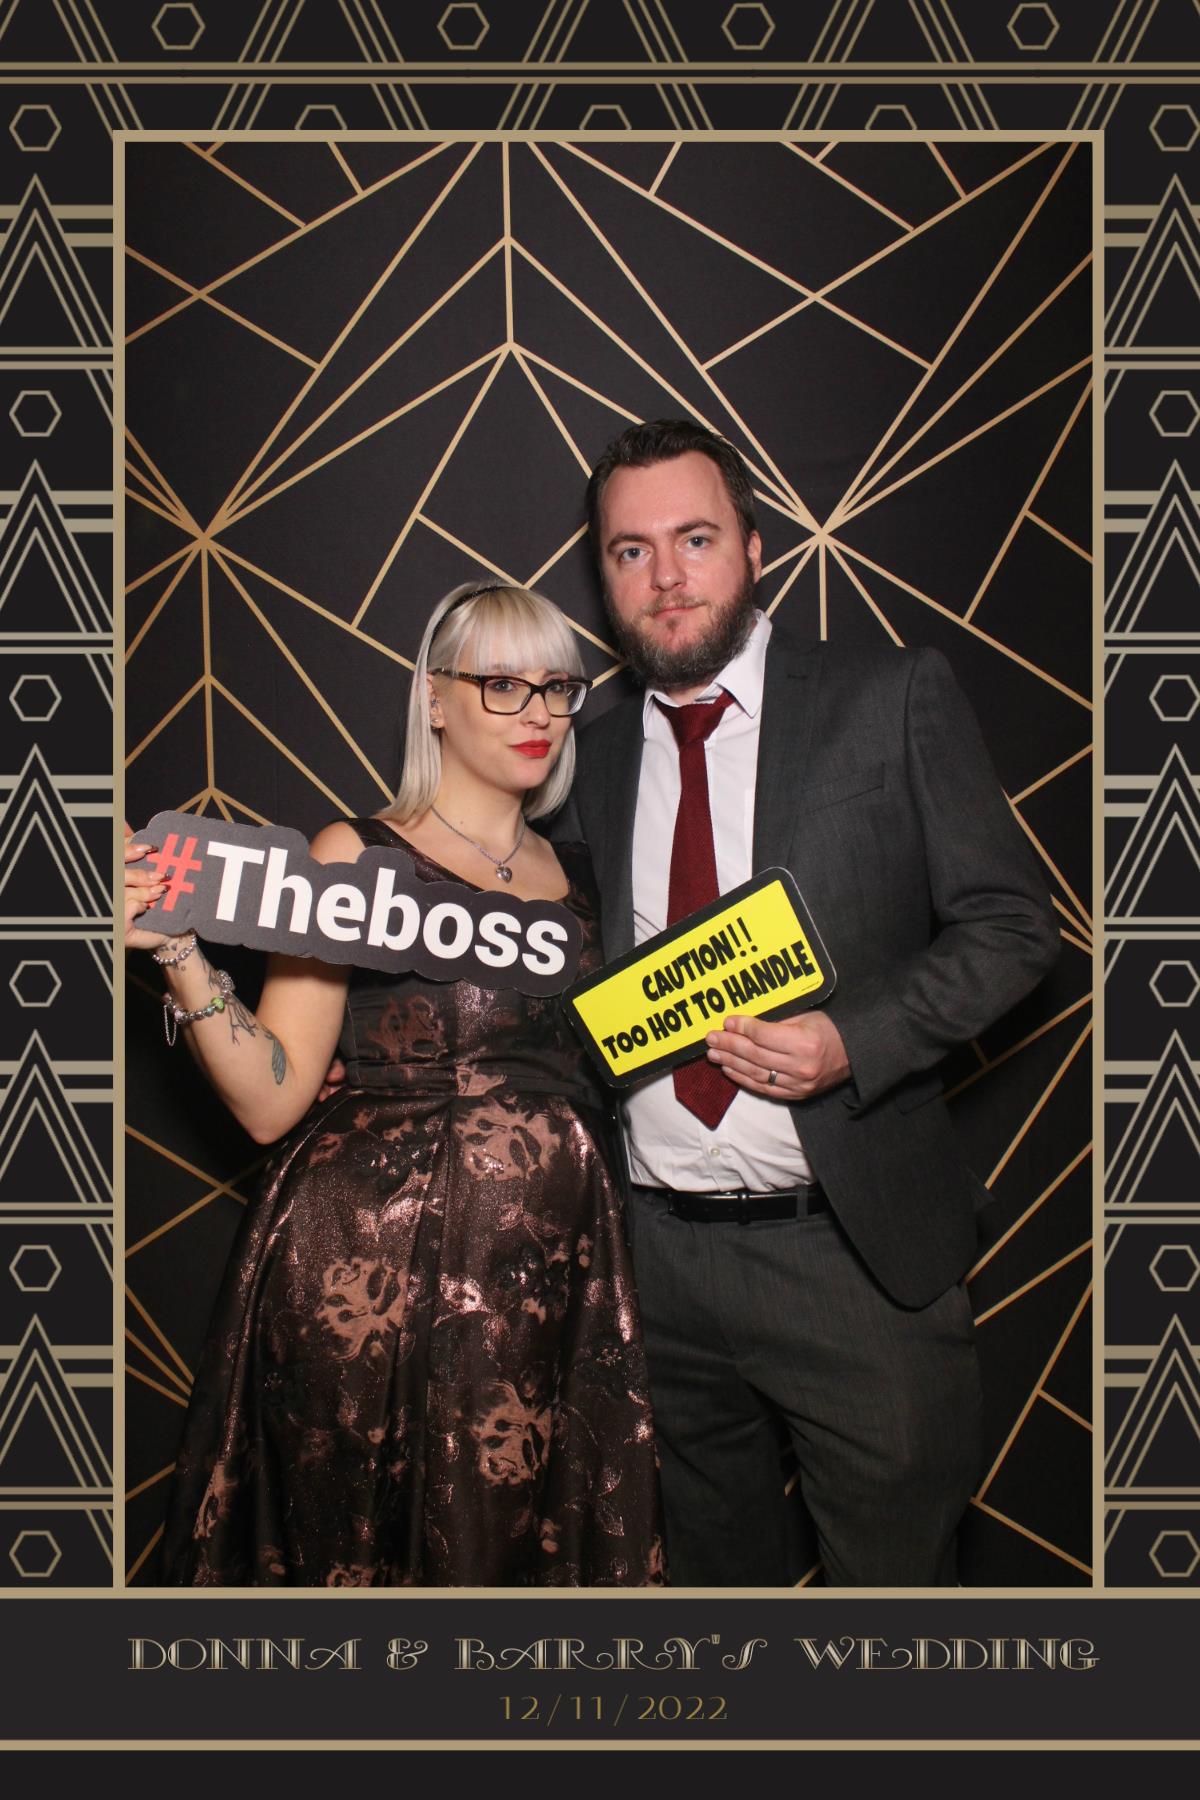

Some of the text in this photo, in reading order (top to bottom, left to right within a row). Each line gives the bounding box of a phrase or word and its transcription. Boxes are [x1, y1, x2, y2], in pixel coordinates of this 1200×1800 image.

[146, 833, 568, 976] #Theboss
[641, 916, 759, 1002] CAUTION!!
[601, 940, 817, 1060] TOO HOT TO HANDLE
